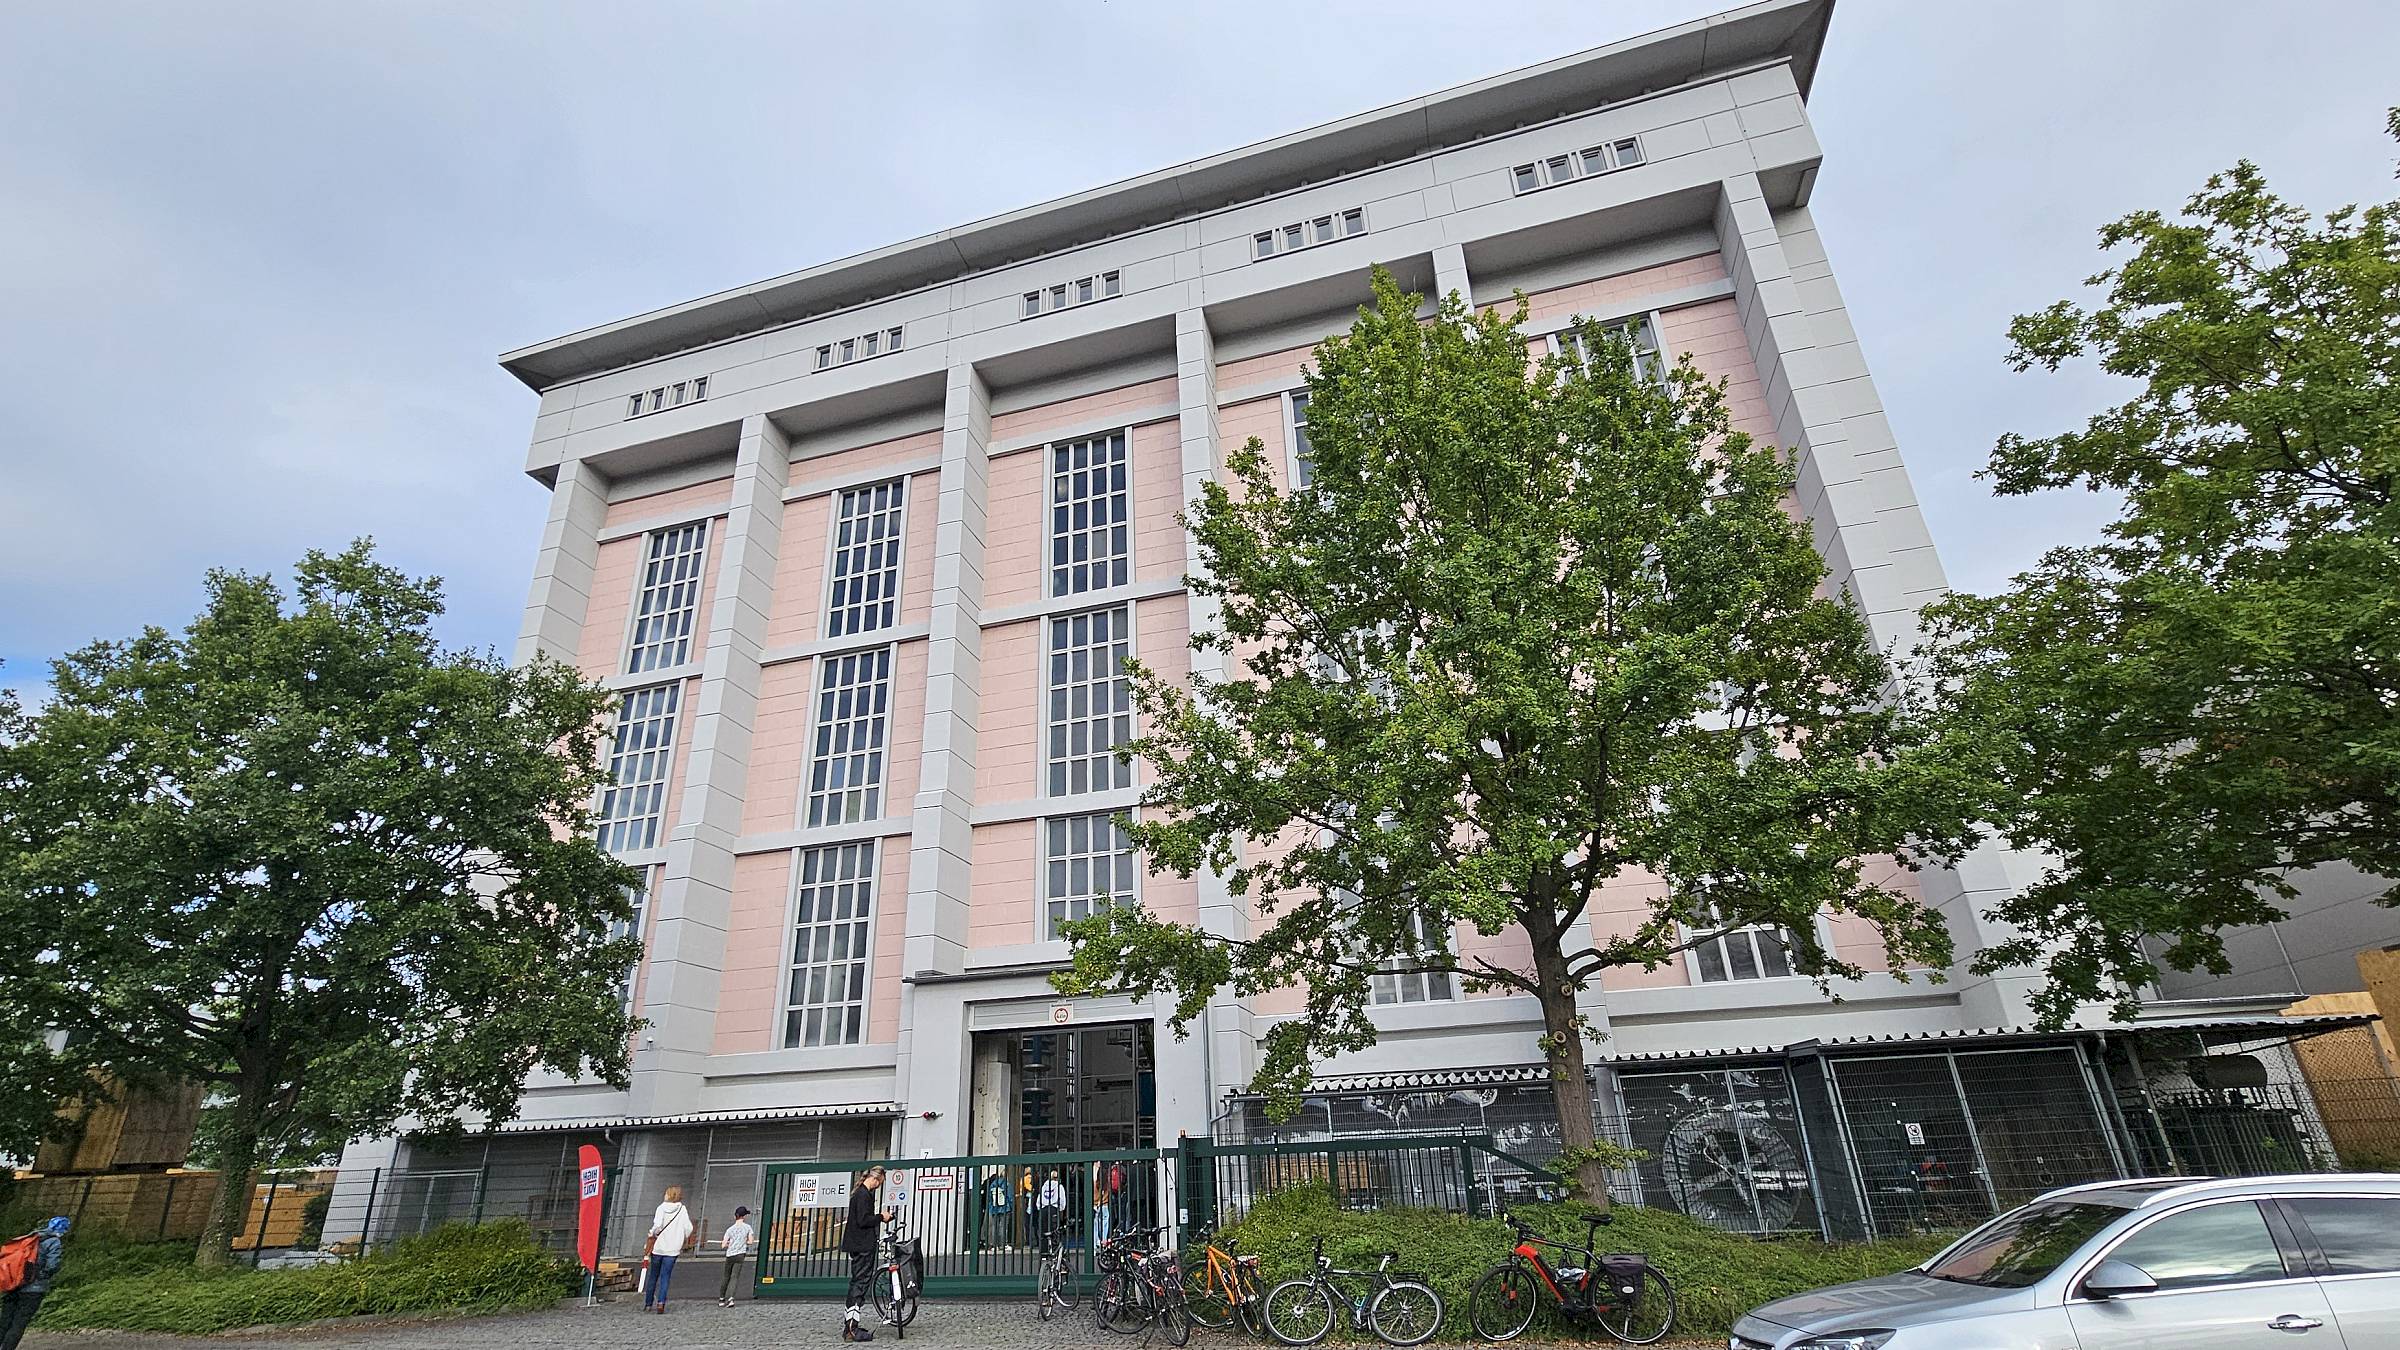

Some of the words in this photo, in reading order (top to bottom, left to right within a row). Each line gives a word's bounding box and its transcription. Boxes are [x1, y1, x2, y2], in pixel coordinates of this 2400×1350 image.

[799, 1179, 817, 1189] HIGH
[821, 1187, 836, 1196] TOR
[838, 1184, 845, 1195] E
[799, 1192, 815, 1202] VOLT
